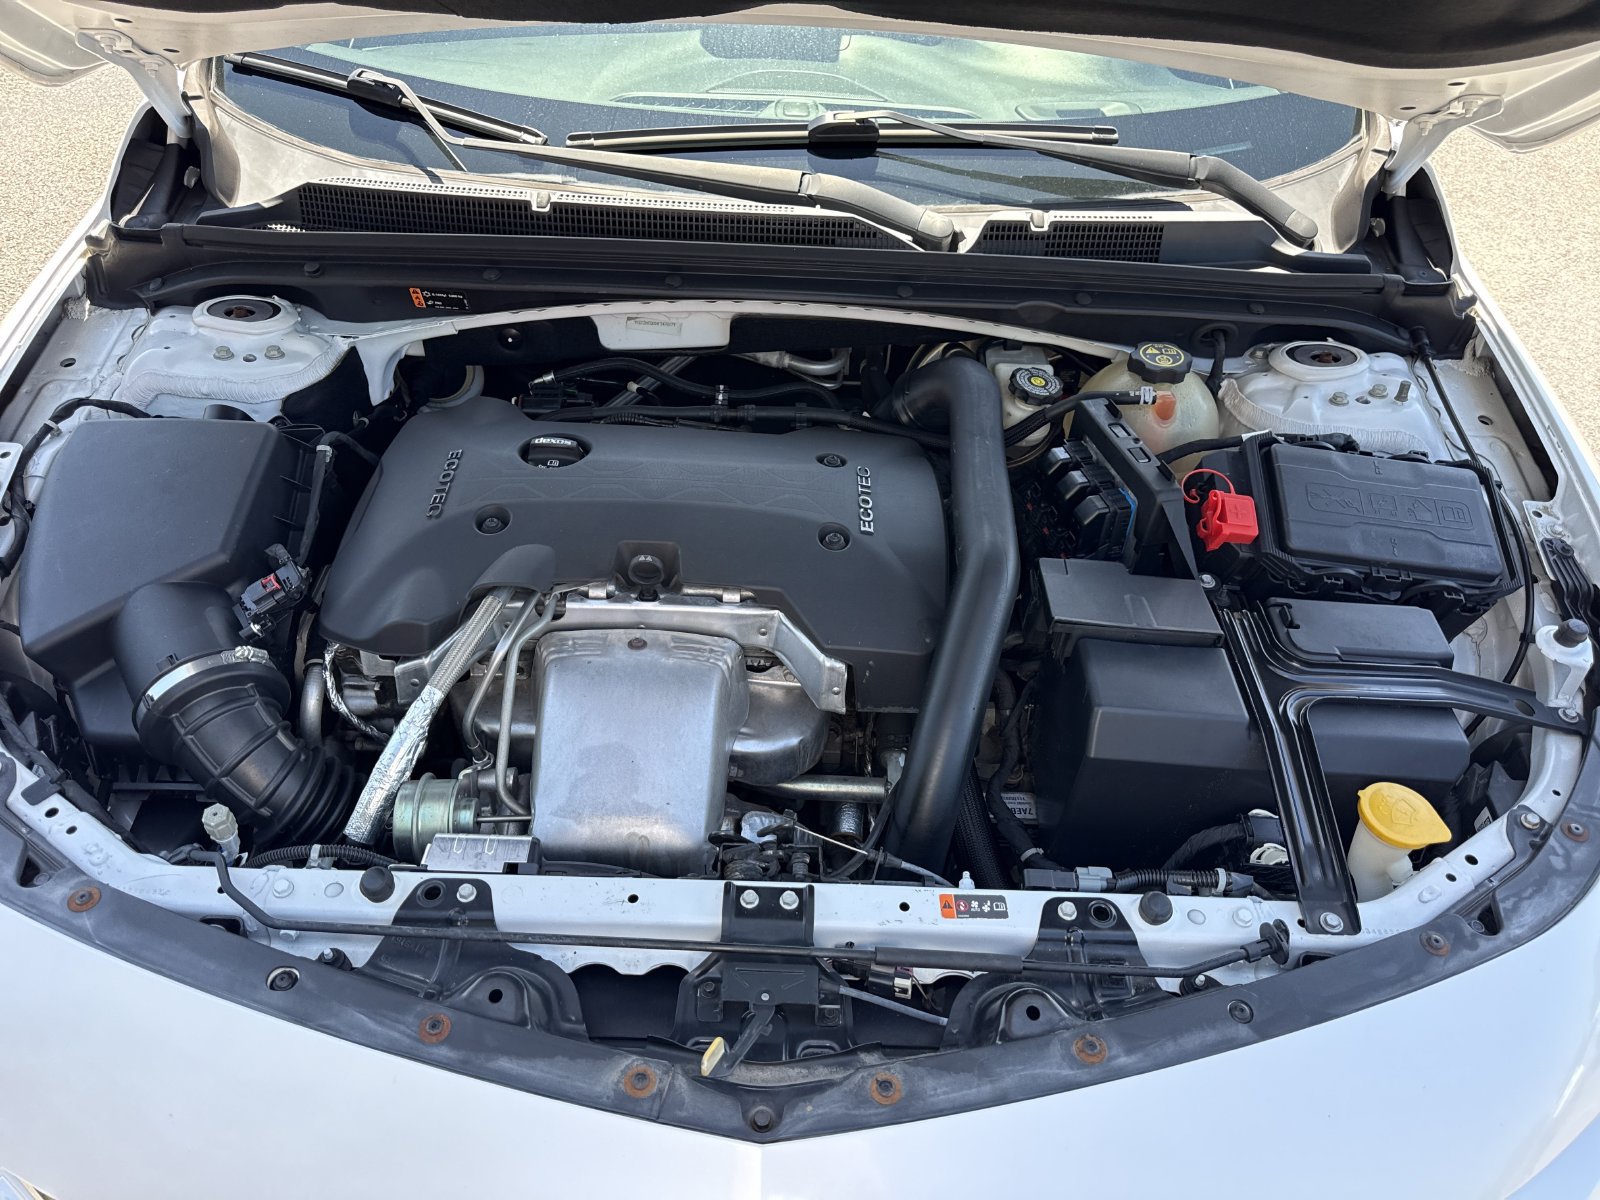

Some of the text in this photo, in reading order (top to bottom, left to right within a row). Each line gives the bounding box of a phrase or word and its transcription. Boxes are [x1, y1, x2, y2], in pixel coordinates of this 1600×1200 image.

[534, 437, 572, 446] dexos
[426, 449, 463, 517] ECOTEC
[856, 466, 874, 533] ECOTEC
